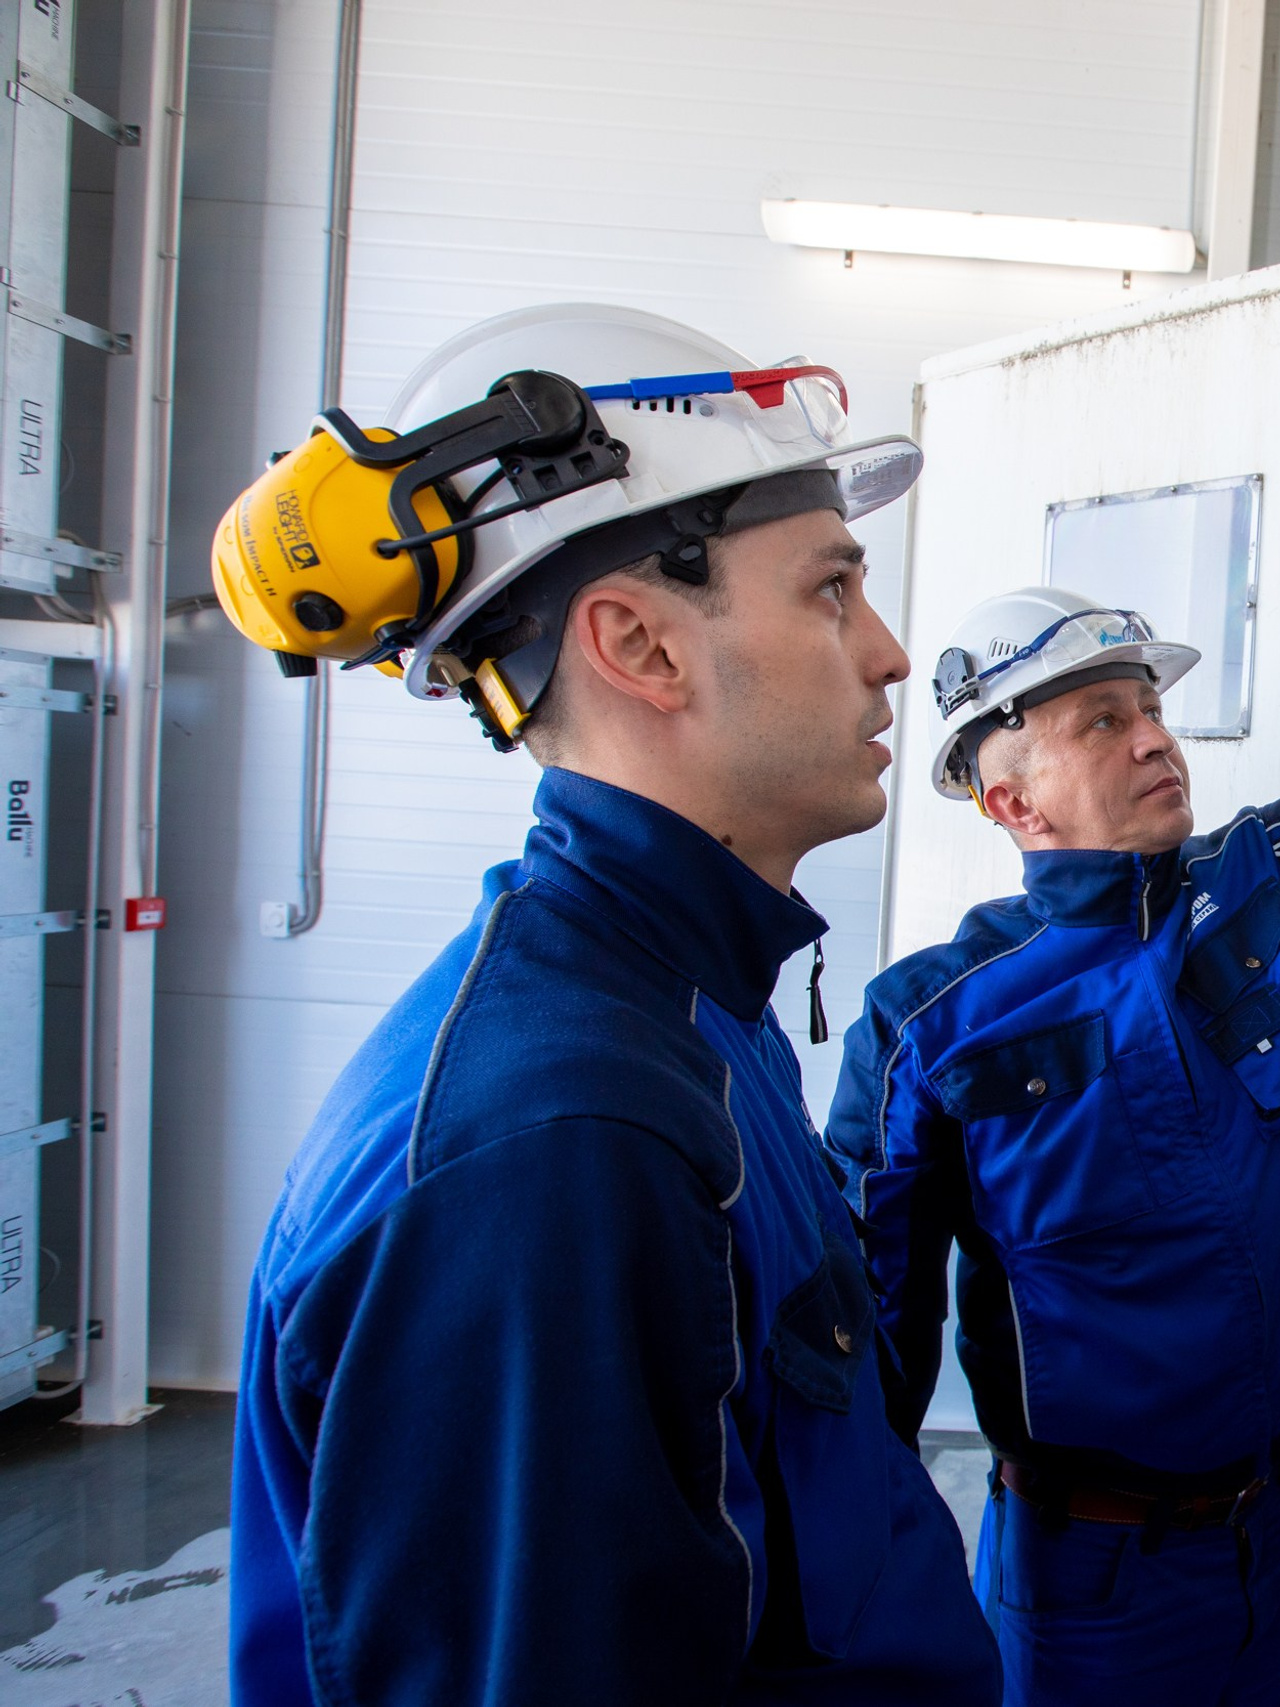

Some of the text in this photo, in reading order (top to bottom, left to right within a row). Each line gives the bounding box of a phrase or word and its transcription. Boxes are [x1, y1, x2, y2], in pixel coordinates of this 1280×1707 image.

[19, 399, 43, 475] ULTRA
[275, 491, 300, 542] LEIGHT
[288, 489, 309, 542] HOWARD
[7, 780, 33, 841] Ballu
[1, 1214, 23, 1294] ULTRA
